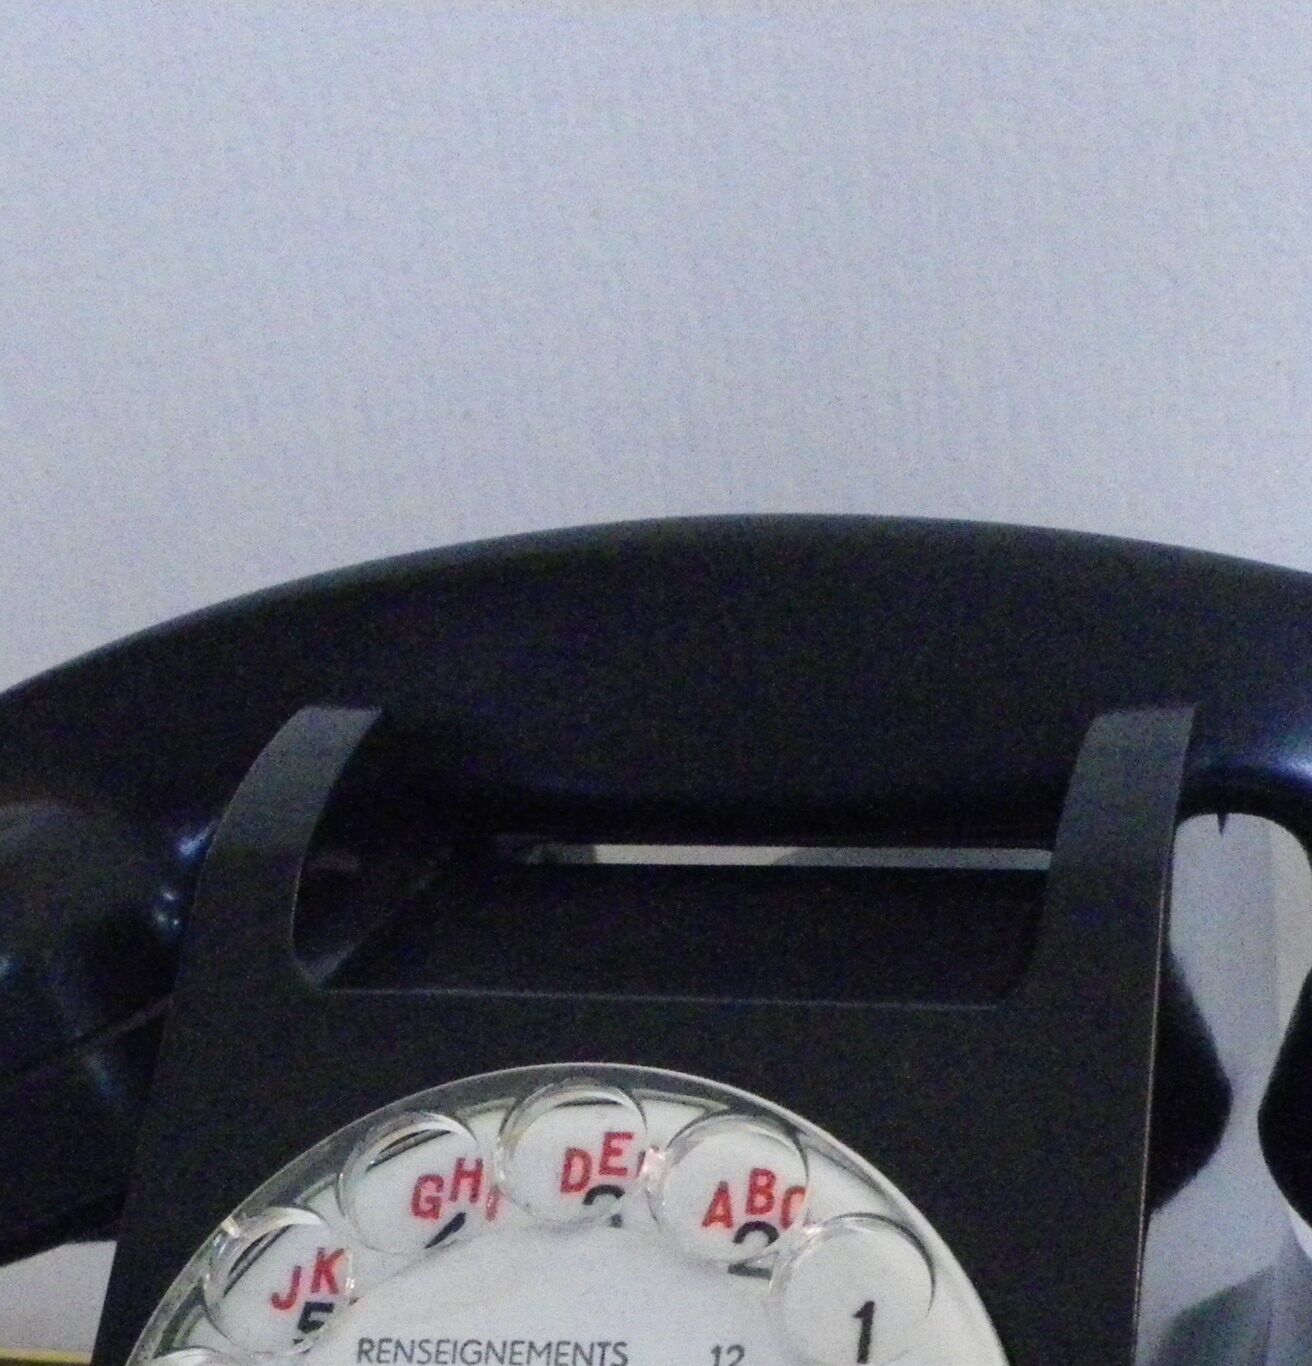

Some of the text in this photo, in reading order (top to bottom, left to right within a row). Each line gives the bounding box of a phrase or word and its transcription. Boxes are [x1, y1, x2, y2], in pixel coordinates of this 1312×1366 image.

[559, 1131, 646, 1193] DE
[728, 1220, 780, 1280] 2
[853, 1300, 875, 1364] 1
